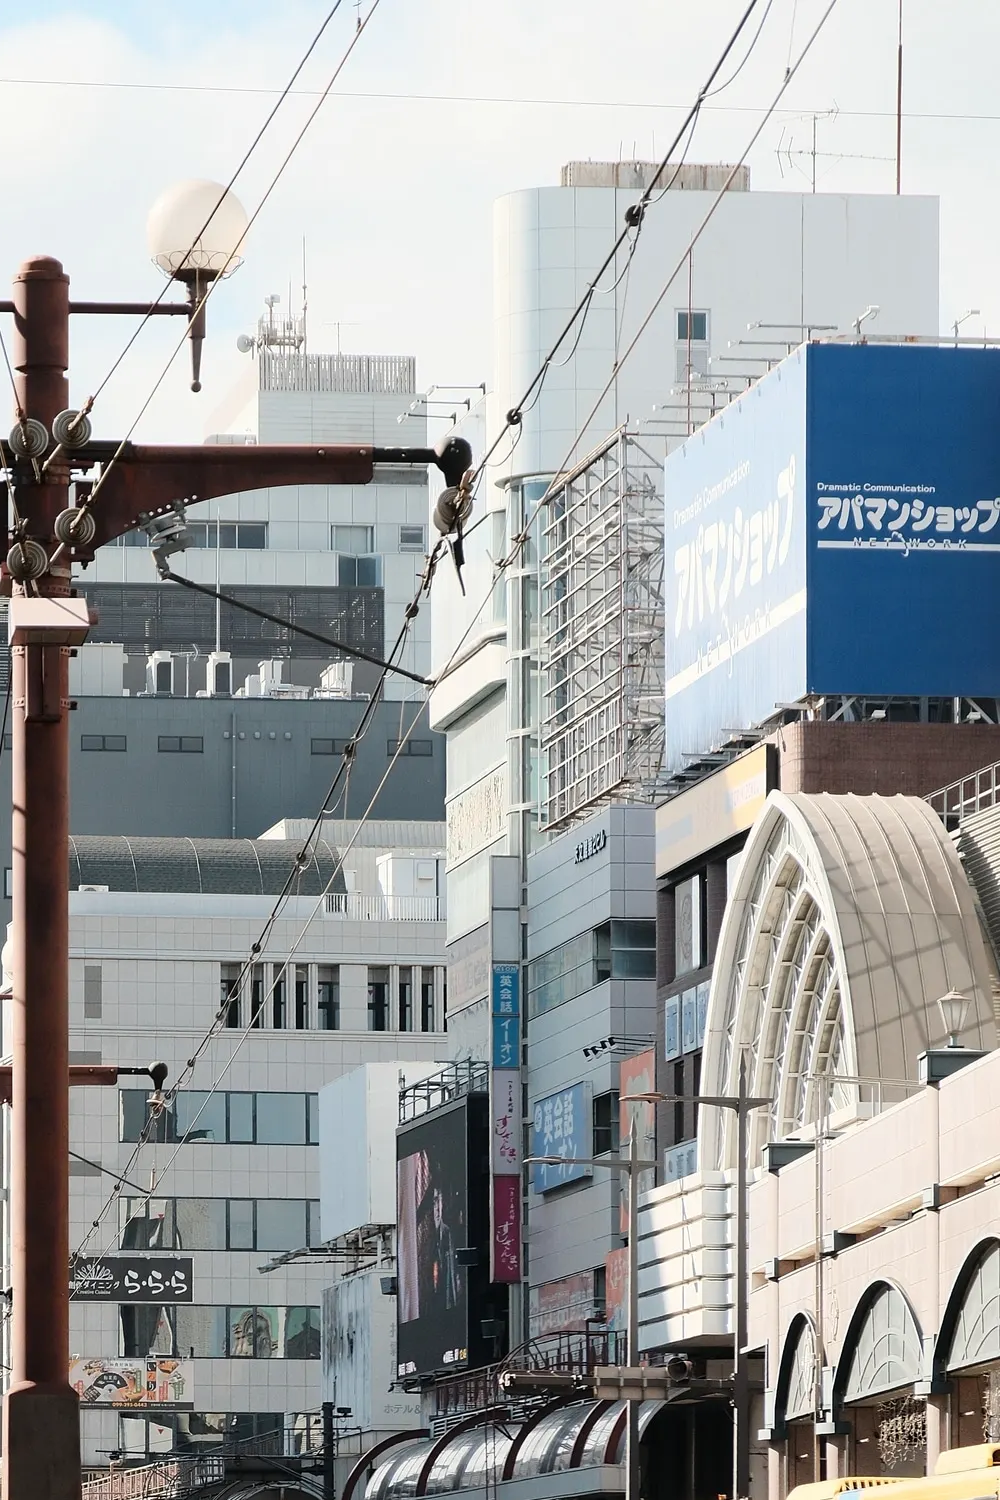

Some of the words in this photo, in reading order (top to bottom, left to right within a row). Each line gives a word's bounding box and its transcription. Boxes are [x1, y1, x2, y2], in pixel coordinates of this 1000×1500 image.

[816, 482, 862, 492] Dramatic
[863, 483, 936, 493] Communication
[817, 494, 1000, 533] アパマンショップ
[674, 452, 796, 639] アパマンショップ
[500, 975, 512, 1013] 英会話
[500, 1018, 512, 1065] イーオン
[543, 1090, 574, 1146] 英会話
